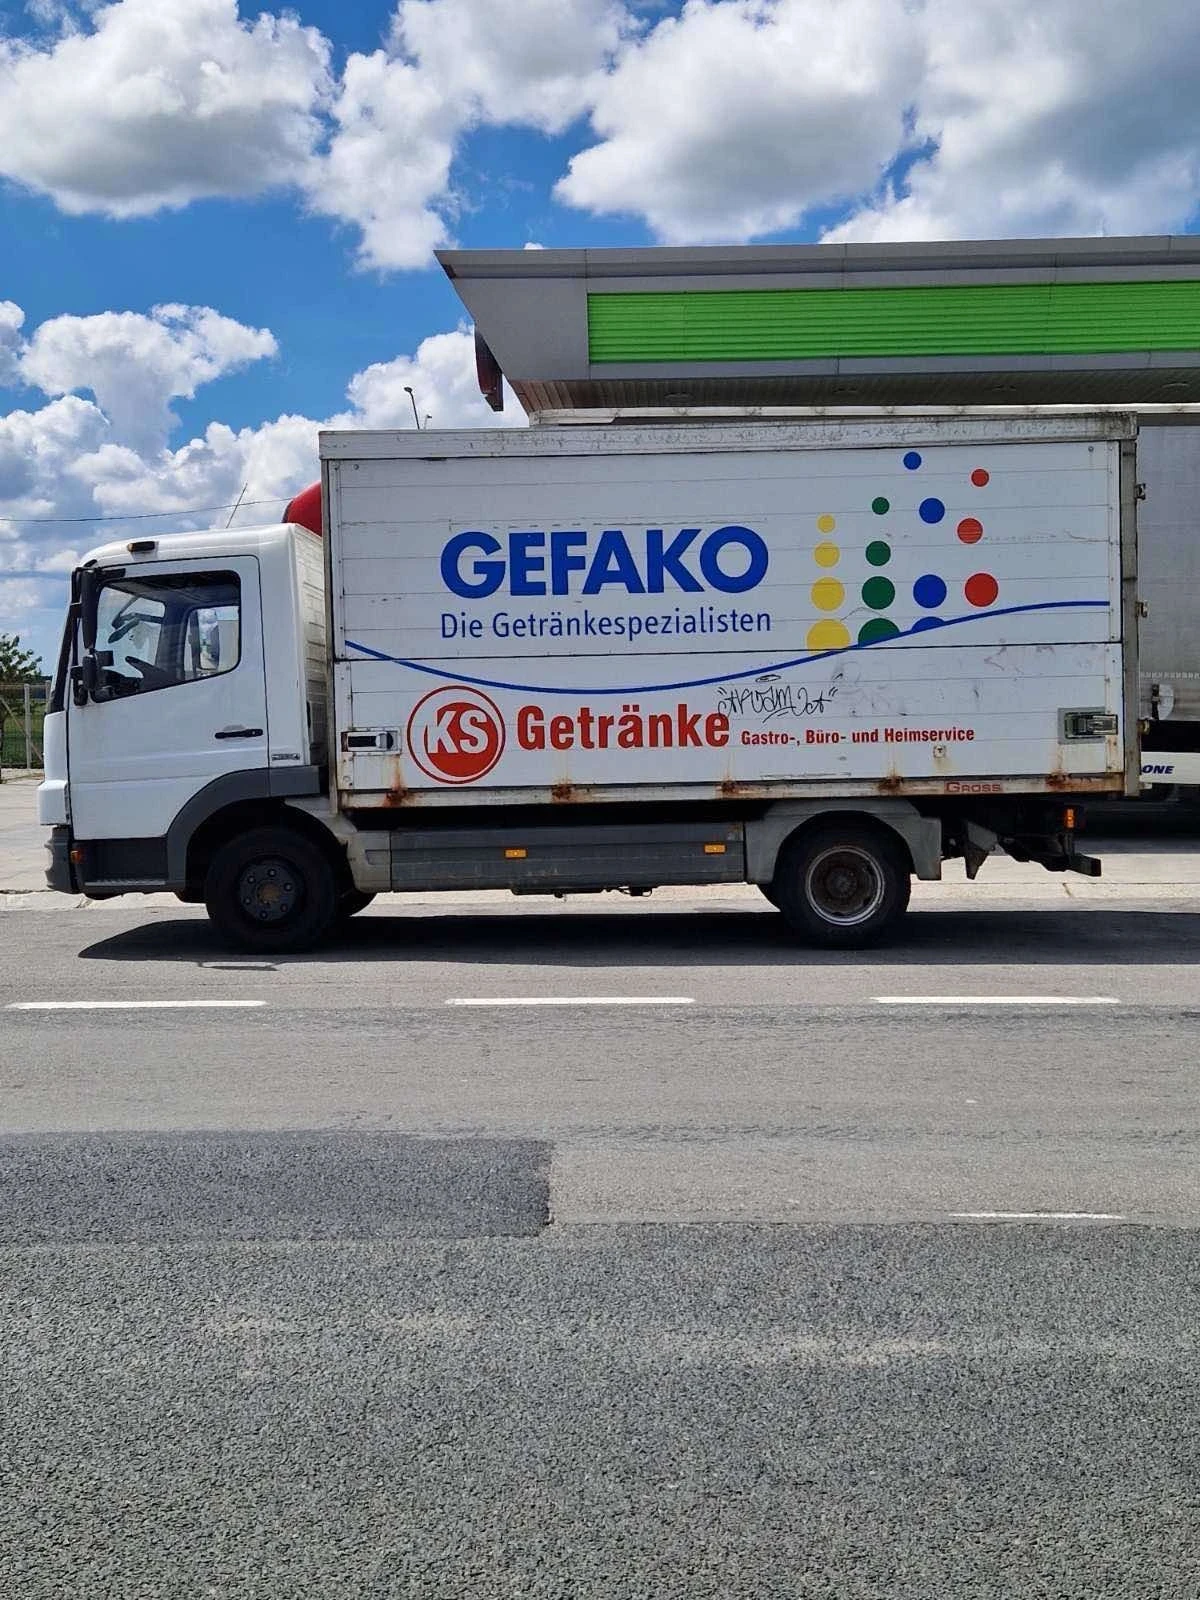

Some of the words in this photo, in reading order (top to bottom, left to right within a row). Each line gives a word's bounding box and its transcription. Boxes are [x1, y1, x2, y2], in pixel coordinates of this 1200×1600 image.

[440, 526, 769, 599] GEFAKO
[441, 613, 483, 638] Die
[492, 606, 771, 641] Getränkespezialisten
[426, 710, 489, 754] KS
[516, 703, 730, 750] Getränke
[741, 730, 800, 746] Gastro-,
[806, 727, 846, 744] Büro-
[852, 728, 879, 743] und
[884, 726, 975, 742] Heimservice
[1140, 764, 1175, 775] ONE
